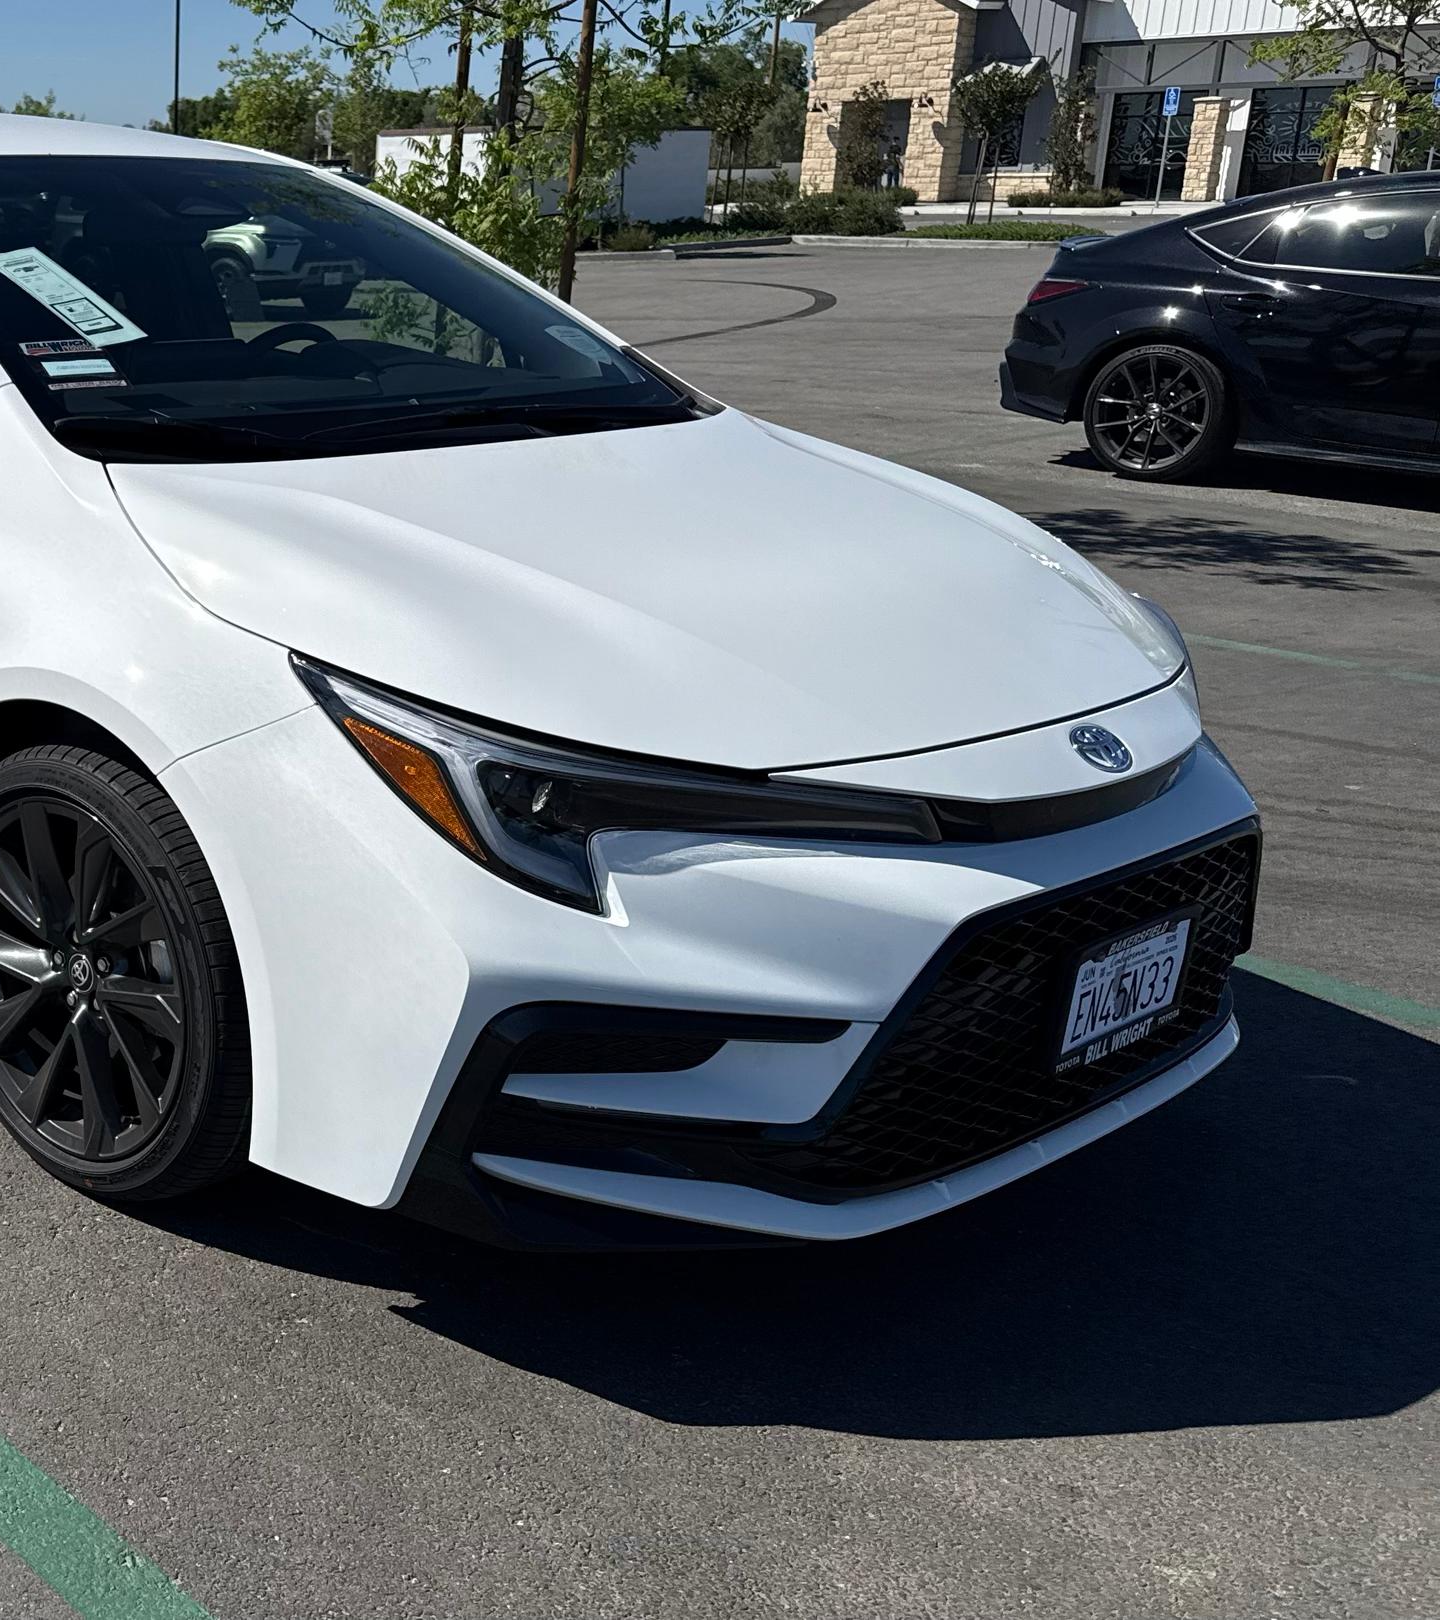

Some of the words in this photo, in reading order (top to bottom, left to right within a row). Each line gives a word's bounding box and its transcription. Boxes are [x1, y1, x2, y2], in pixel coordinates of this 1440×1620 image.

[1107, 921, 1170, 956] BAKERSFIELD
[1081, 965, 1096, 983] JUN
[1070, 956, 1175, 1044] EN45N33
[1084, 1038, 1109, 1065] BILL
[1110, 1016, 1154, 1053] WRIGHT
